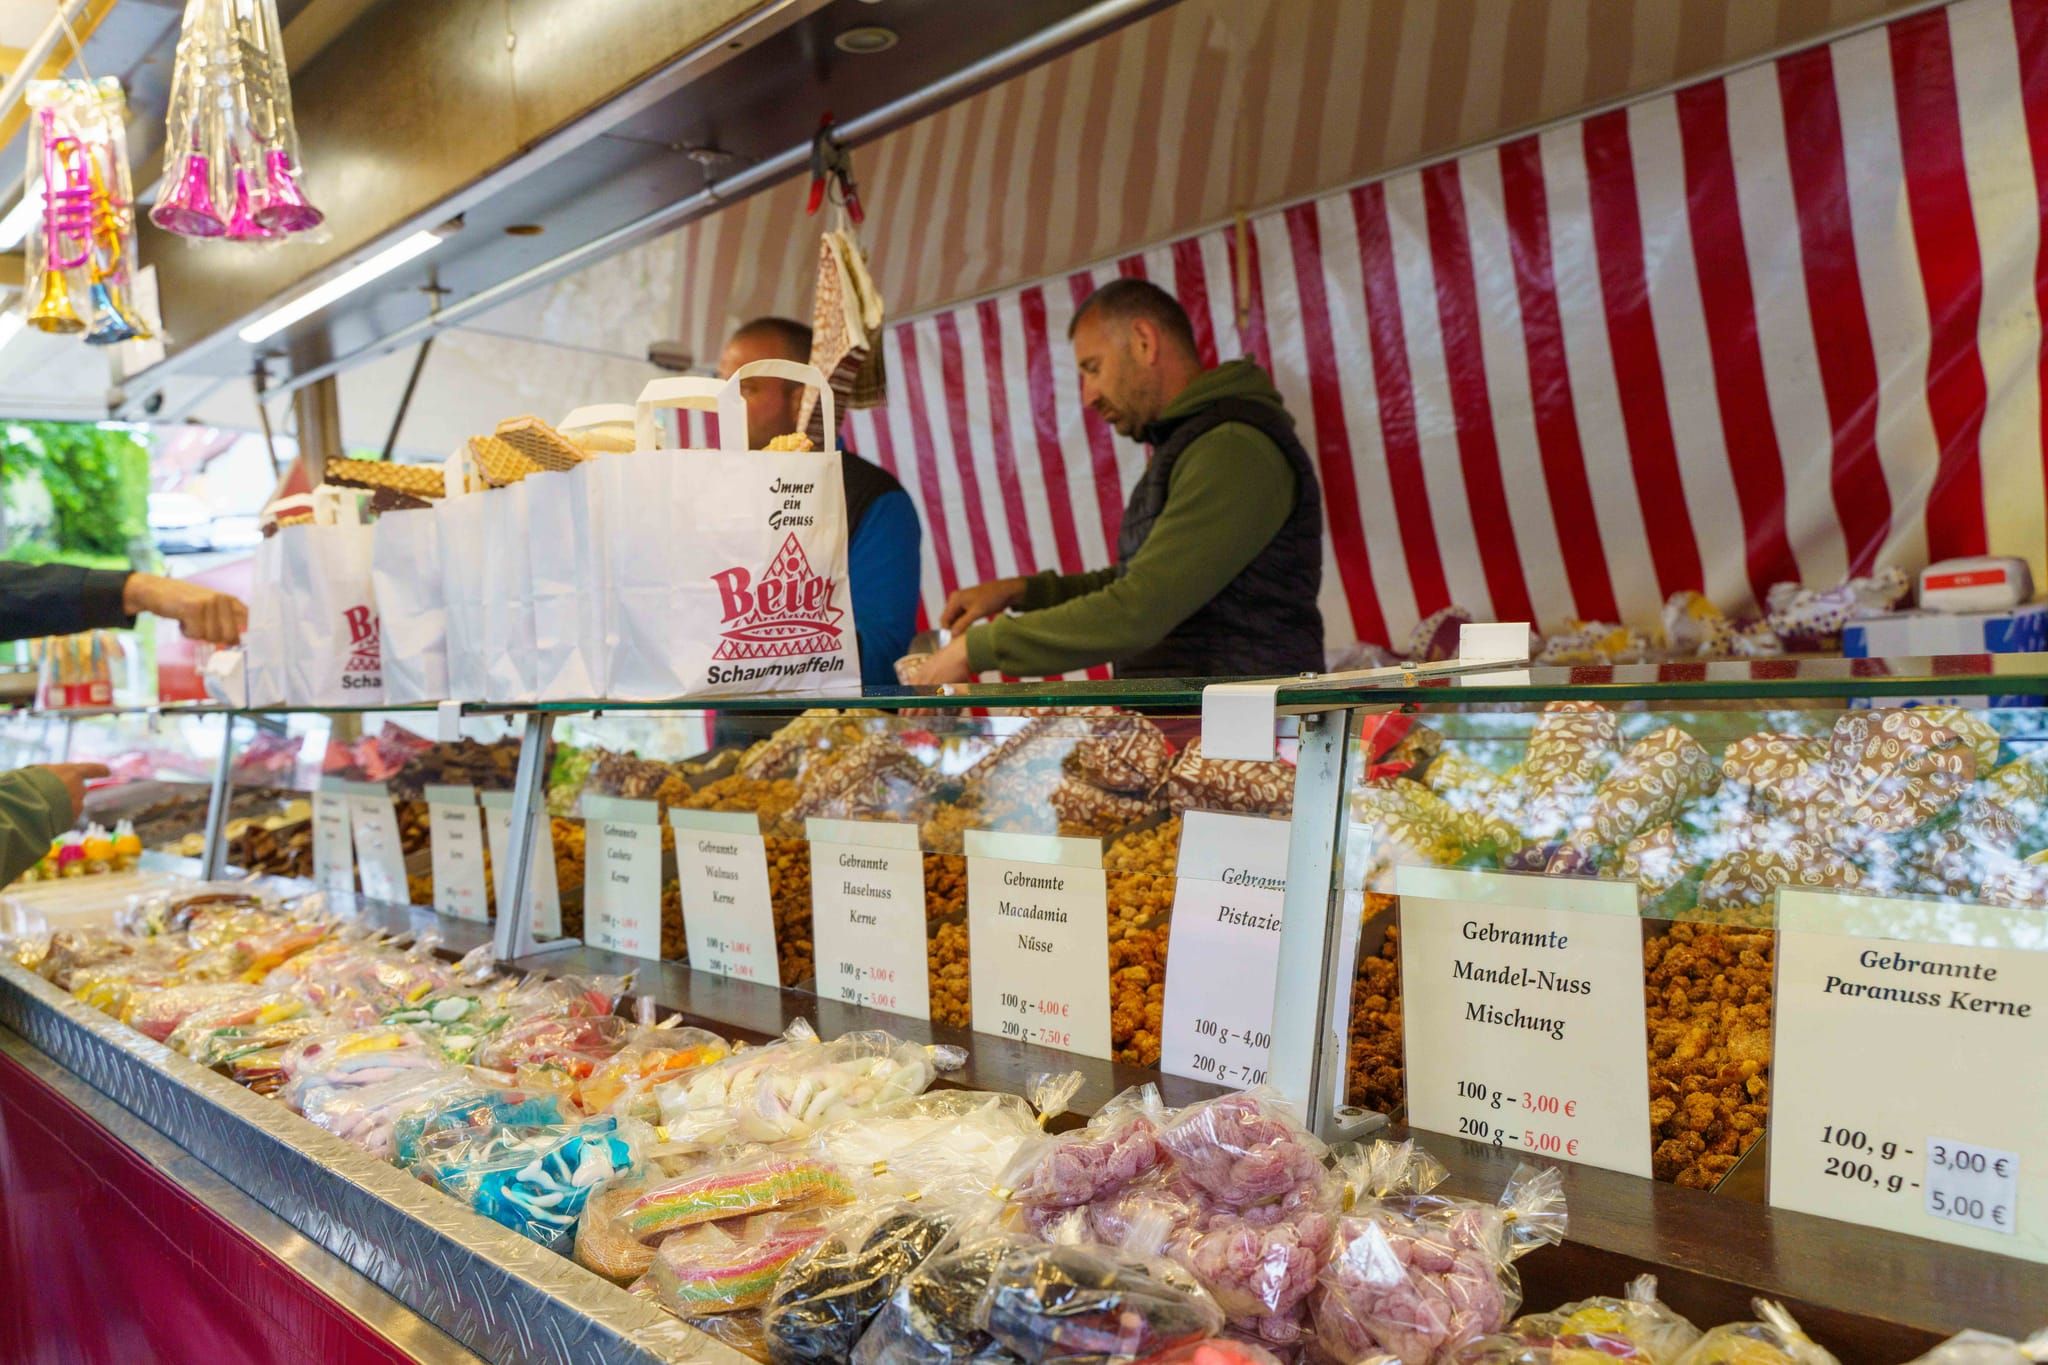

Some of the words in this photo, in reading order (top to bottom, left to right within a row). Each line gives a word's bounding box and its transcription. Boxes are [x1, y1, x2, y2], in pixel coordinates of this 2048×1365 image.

[769, 478, 814, 494] Immer
[783, 494, 801, 510] ein
[768, 510, 814, 530] Genuss
[709, 566, 844, 624] Beier
[707, 656, 844, 684] Schaumwaffeln
[698, 840, 739, 856] Gebrannte
[705, 865, 739, 881] Walnuss
[839, 853, 889, 871] Gebrannte
[842, 881, 892, 899] Haselnuss
[1003, 871, 1065, 891] Gebrannte
[712, 890, 736, 905] Kerne
[849, 909, 877, 926] Kerne
[998, 901, 1068, 923] Macadamia
[1217, 906, 1282, 932] Pistazie
[1018, 934, 1054, 953] Nüsse
[1462, 921, 1568, 950] Gebrannte
[840, 962, 854, 975] 100
[855, 968, 861, 981] g
[889, 970, 895, 983] €
[1452, 960, 1592, 995] Mandel-Nuss
[1860, 949, 1998, 981] Gebrannte
[841, 986, 855, 1000] 200
[857, 993, 862, 1006] g
[890, 996, 896, 1008] €
[1001, 992, 1018, 1008] 100
[1020, 1000, 1027, 1014] g
[1038, 999, 1059, 1017] 4,00
[1062, 1004, 1069, 1017] €
[1823, 976, 1941, 1007] Paranuss
[1947, 991, 2032, 1018] Kerne
[1002, 1020, 1019, 1036] 200
[1022, 1028, 1029, 1042] g
[1040, 1028, 1060, 1044] 7,50
[1063, 1033, 1070, 1046] €
[1465, 1002, 1566, 1040] Mischung
[1195, 1019, 1217, 1036] 100
[1219, 1028, 1228, 1044] g
[1243, 1030, 1271, 1049] 4,00
[1192, 1054, 1215, 1073] 200
[1216, 1065, 1226, 1080] g
[1457, 1080, 1487, 1100] 100
[1490, 1091, 1502, 1109] g
[1522, 1092, 1559, 1113] 3,00
[1564, 1100, 1577, 1118] €
[1459, 1117, 1489, 1138] 200
[1493, 1129, 1504, 1147] g
[1523, 1130, 1561, 1152] 5,00
[1566, 1138, 1579, 1156] €
[1881, 1141, 1898, 1161] g
[1932, 1145, 1986, 1173] 3,00
[1993, 1158, 2010, 1178] €
[1887, 1173, 1904, 1193] g
[1932, 1190, 1984, 1219] 5,00
[1992, 1204, 2007, 1225] €
